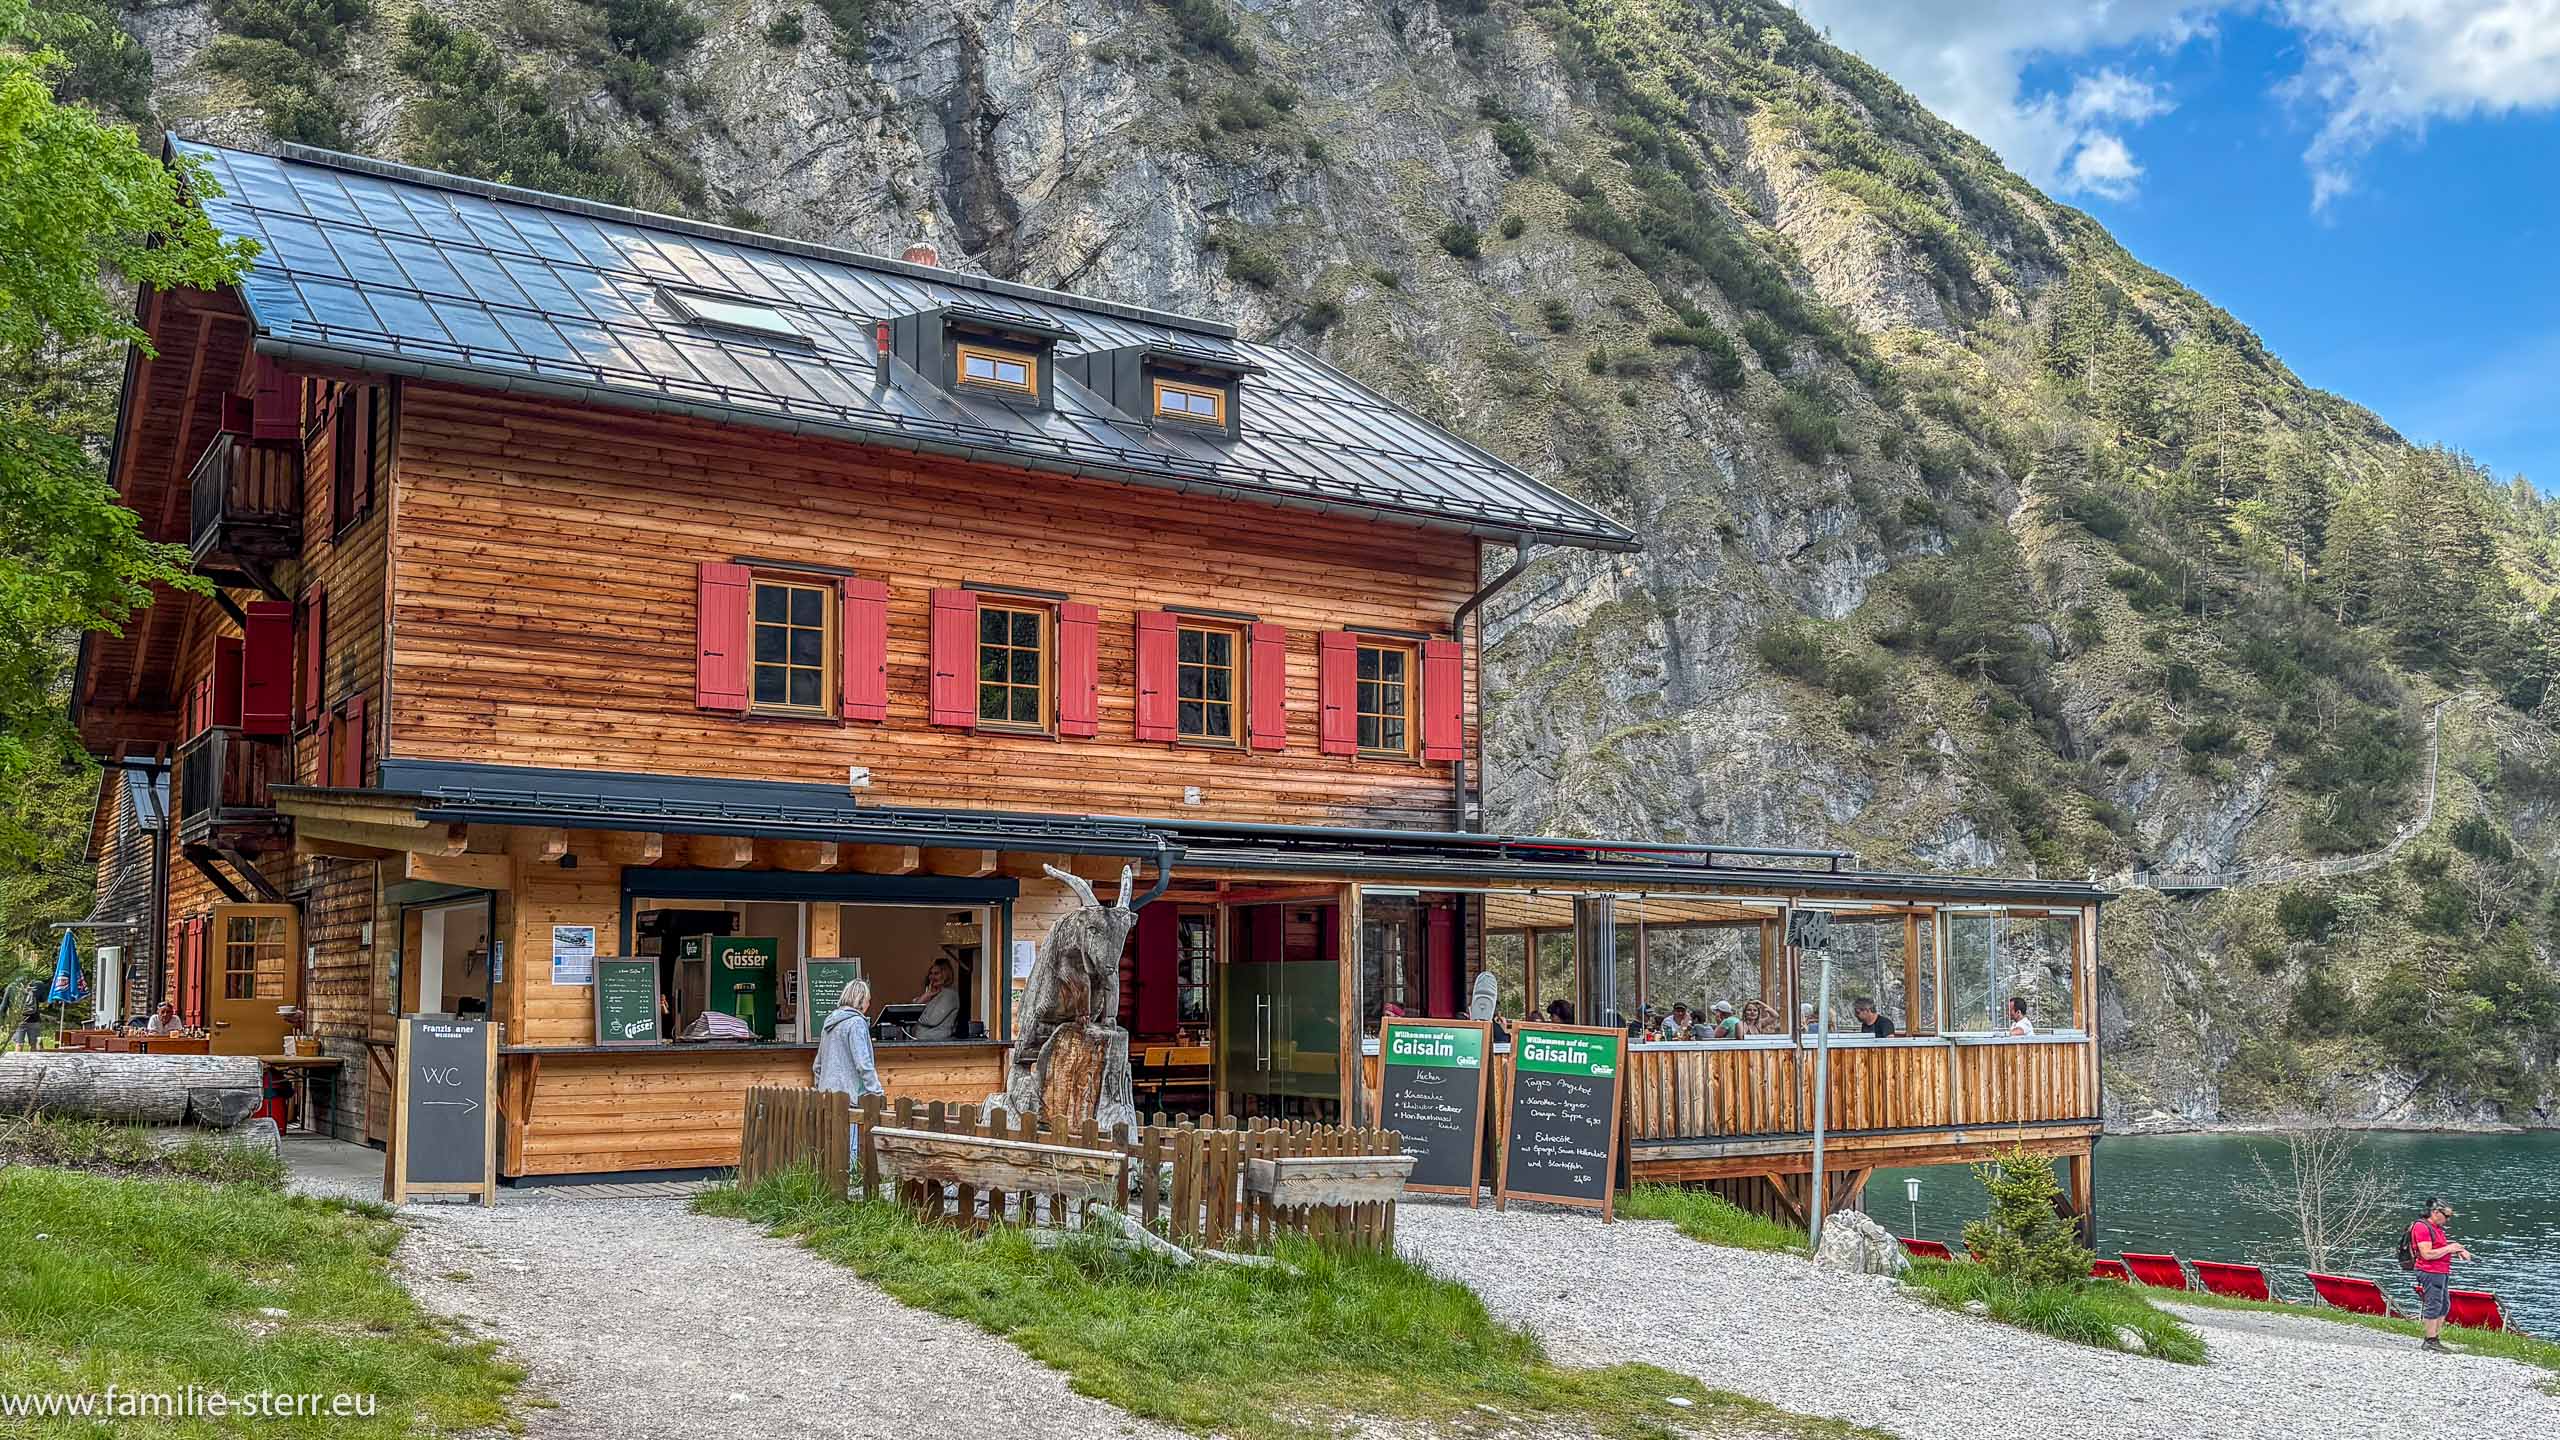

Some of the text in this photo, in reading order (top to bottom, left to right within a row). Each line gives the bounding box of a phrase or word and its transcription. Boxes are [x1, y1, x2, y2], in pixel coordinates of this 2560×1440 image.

[722, 948, 768, 969] Gösser
[625, 1022, 654, 1039] Gösser
[1394, 1031, 1455, 1041] Willkommen auf der
[1393, 1039, 1454, 1057] Gaisalm
[1526, 1036, 1589, 1048] Willkommen auf der
[1524, 1044, 1588, 1065] Gaisalm
[421, 1066, 462, 1086] WC
[1524, 1077, 1593, 1096] Tages Angebot
